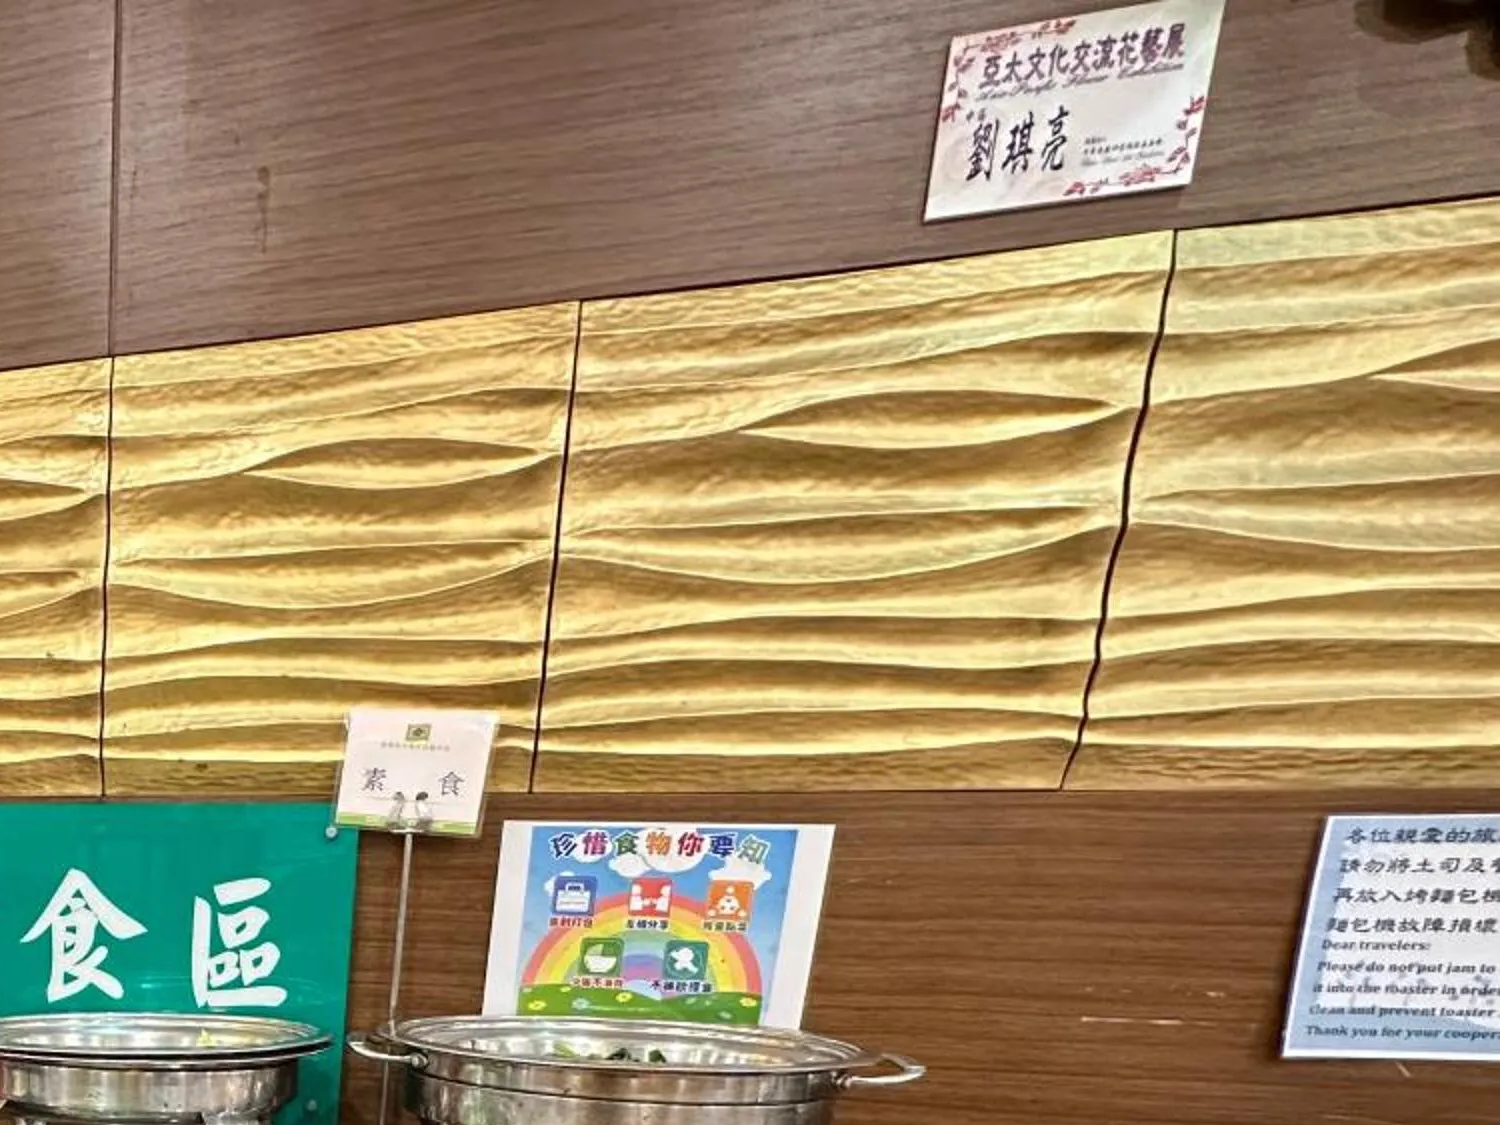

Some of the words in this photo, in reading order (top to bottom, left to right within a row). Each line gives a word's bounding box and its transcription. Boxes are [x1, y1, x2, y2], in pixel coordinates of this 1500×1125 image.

[1346, 826, 1500, 844] 各位親愛的旅
[551, 831, 768, 864] 珍惜食物你要知
[1322, 939, 1356, 950] Dear
[1317, 961, 1362, 973] Please
[1365, 961, 1385, 973] do
[1416, 963, 1443, 975] put
[1445, 961, 1476, 975] jam
[1479, 963, 1497, 973] to
[1357, 983, 1381, 993] the
[1441, 983, 1457, 995] in
[1348, 1004, 1376, 1015] and
[1440, 1006, 1496, 1017] toaster
[1305, 1024, 1348, 1036] Thank
[1350, 1027, 1378, 1039] you
[1381, 1026, 1403, 1037] for
[1405, 1028, 1442, 1041] your
[1443, 1030, 1500, 1042] cooper
